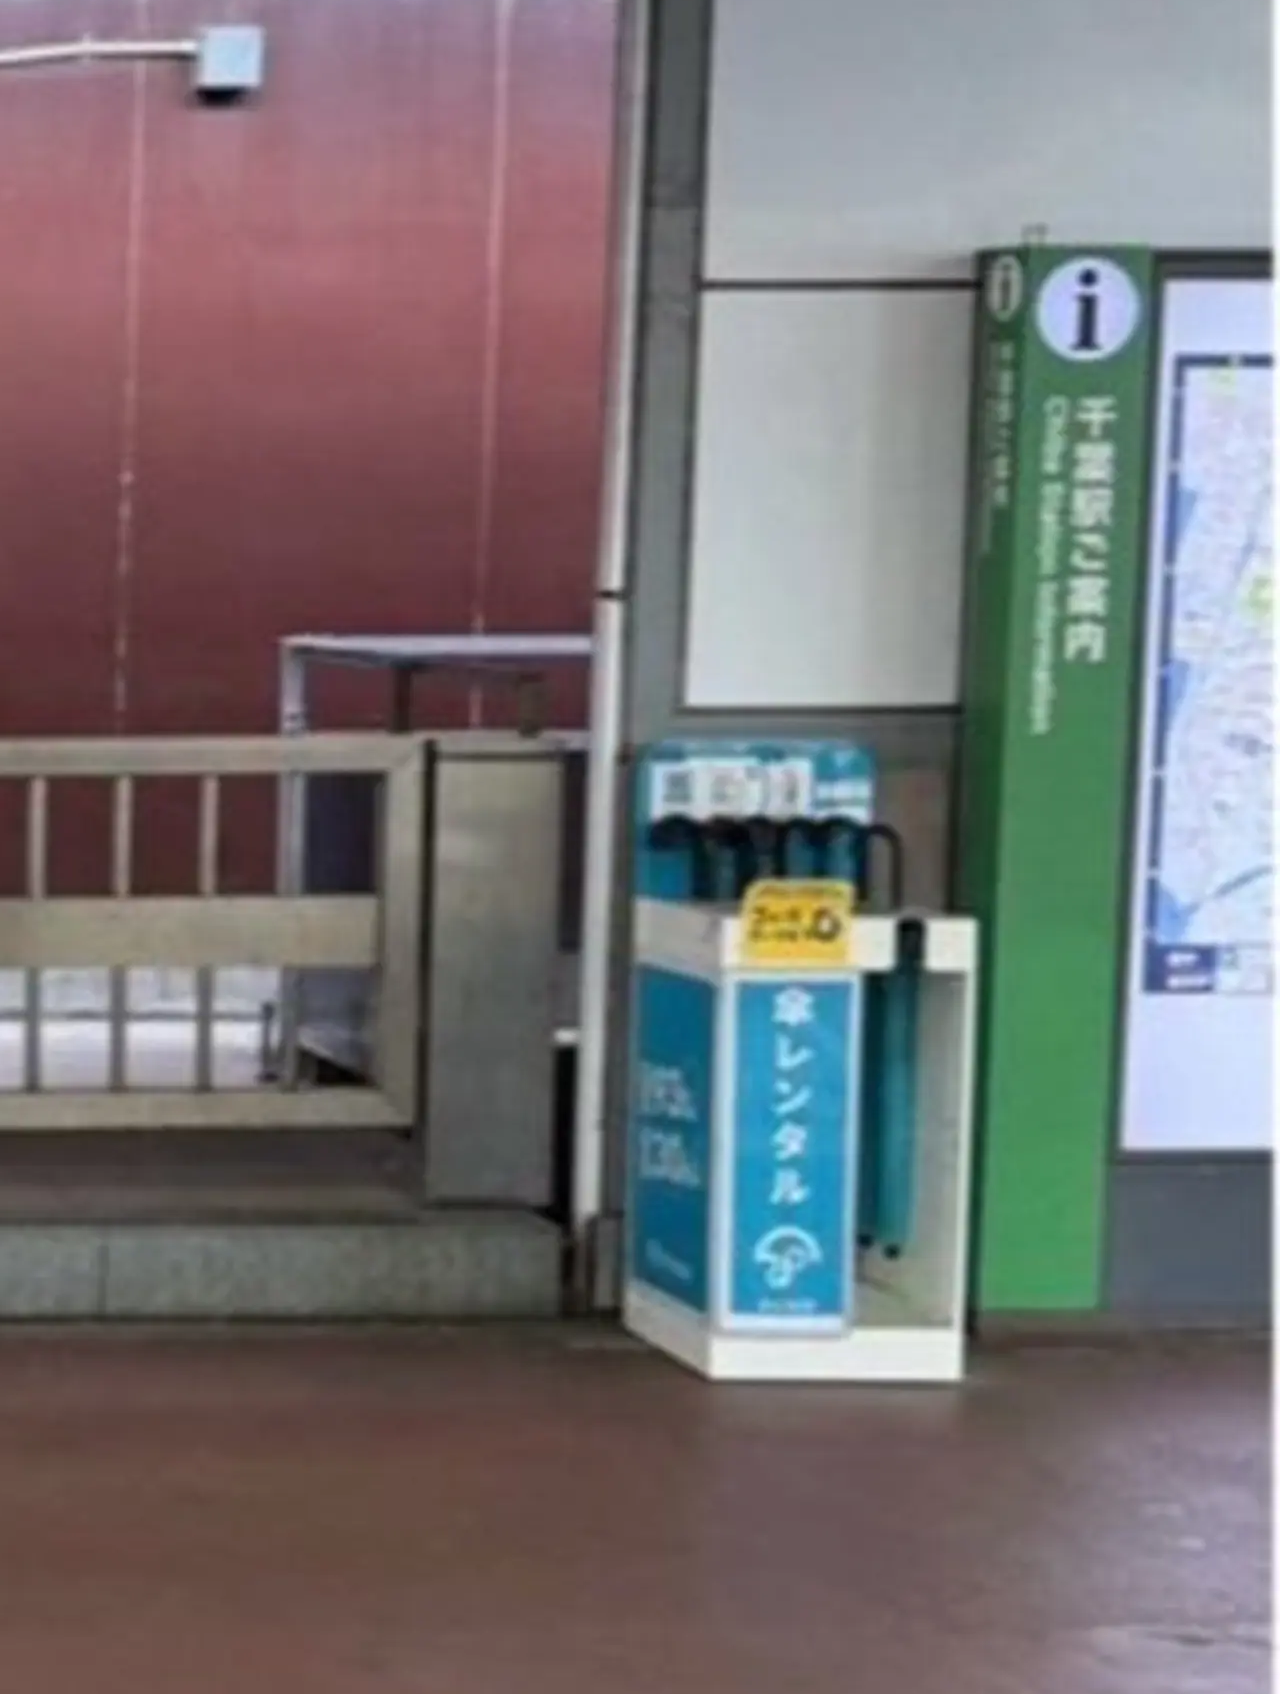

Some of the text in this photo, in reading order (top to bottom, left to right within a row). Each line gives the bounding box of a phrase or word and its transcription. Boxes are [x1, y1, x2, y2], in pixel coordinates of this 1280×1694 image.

[1042, 395, 1068, 475] Chiba
[1062, 395, 1118, 665] 千葉駅ご案内
[770, 987, 814, 1205] 傘レンタル
